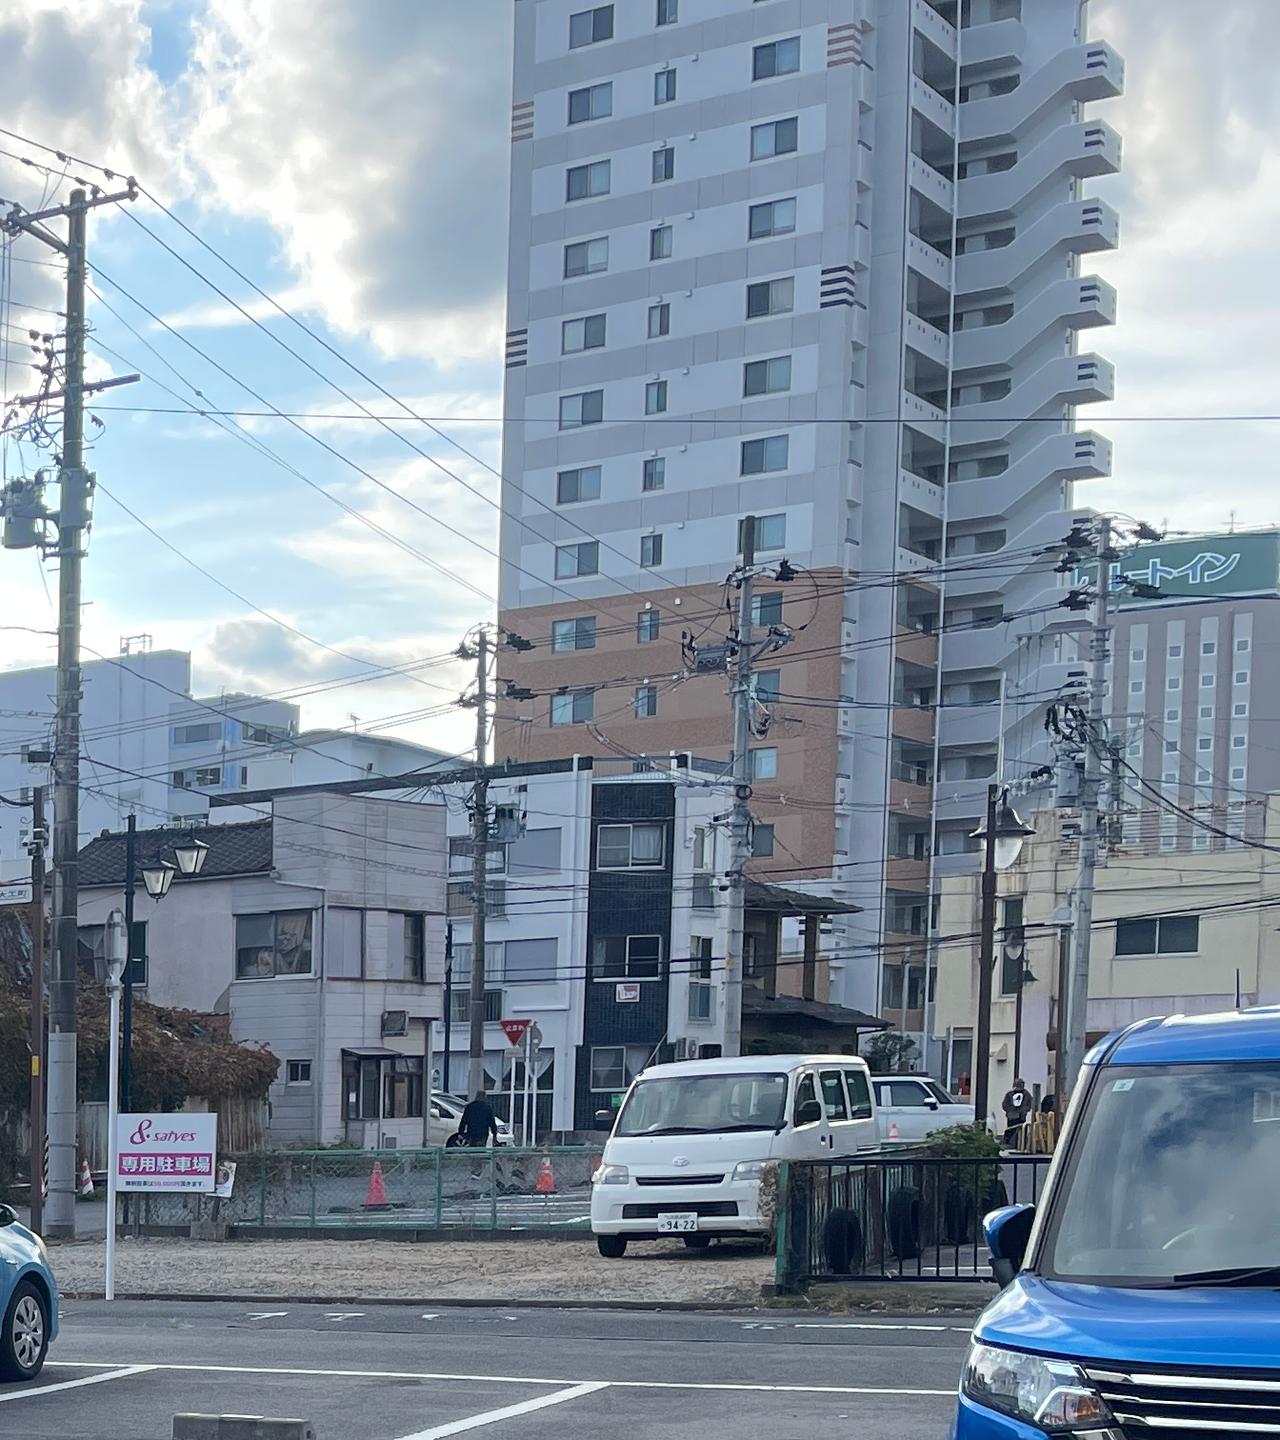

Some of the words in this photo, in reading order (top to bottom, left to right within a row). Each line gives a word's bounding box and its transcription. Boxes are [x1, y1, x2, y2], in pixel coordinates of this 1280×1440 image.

[121, 1156, 211, 1173] 専用駐車場
